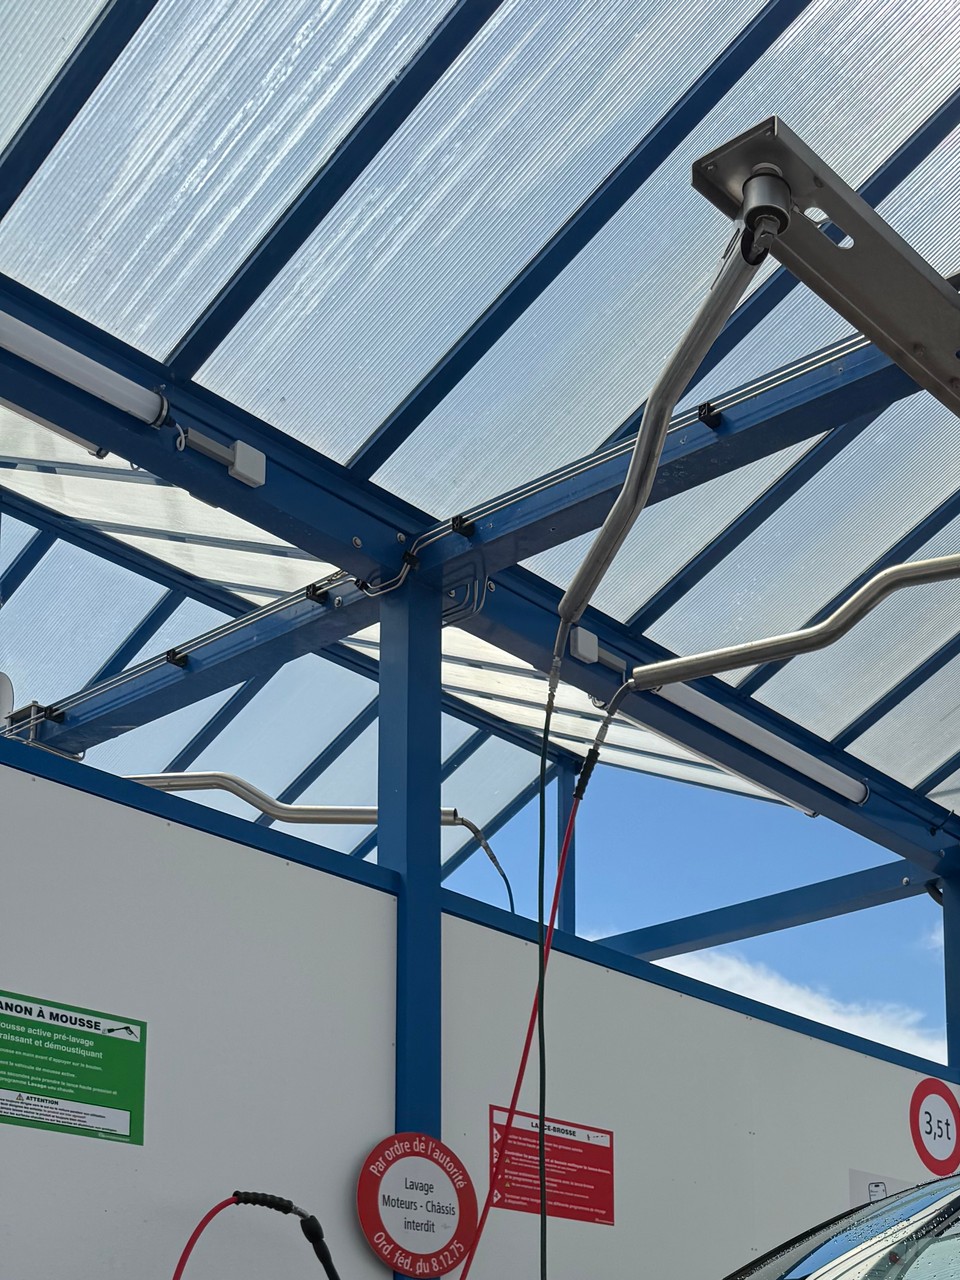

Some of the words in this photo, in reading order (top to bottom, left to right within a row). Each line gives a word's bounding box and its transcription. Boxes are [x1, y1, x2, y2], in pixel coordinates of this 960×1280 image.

[37, 1007, 46, 1020] À
[49, 1012, 102, 1031] MOUSSE
[27, 1027, 52, 1038] active
[53, 1032, 95, 1048] pré-lavage
[34, 1039, 43, 1048] et
[44, 1040, 104, 1060] démoustiquant
[26, 1096, 59, 1106] ATTENTION
[531, 1121, 577, 1137] LACE-BROSSE
[369, 1156, 387, 1177] Par
[385, 1140, 411, 1161] ordre
[427, 1141, 468, 1189] l'autorité
[404, 1177, 435, 1196] Lavage
[382, 1194, 418, 1211] Moteurs
[426, 1200, 456, 1217] Châssis
[403, 1216, 436, 1234] interdit
[373, 1232, 394, 1259] Ord.
[392, 1250, 414, 1272] féd.
[416, 1258, 430, 1273] du
[431, 1239, 465, 1272] 8.12.75
